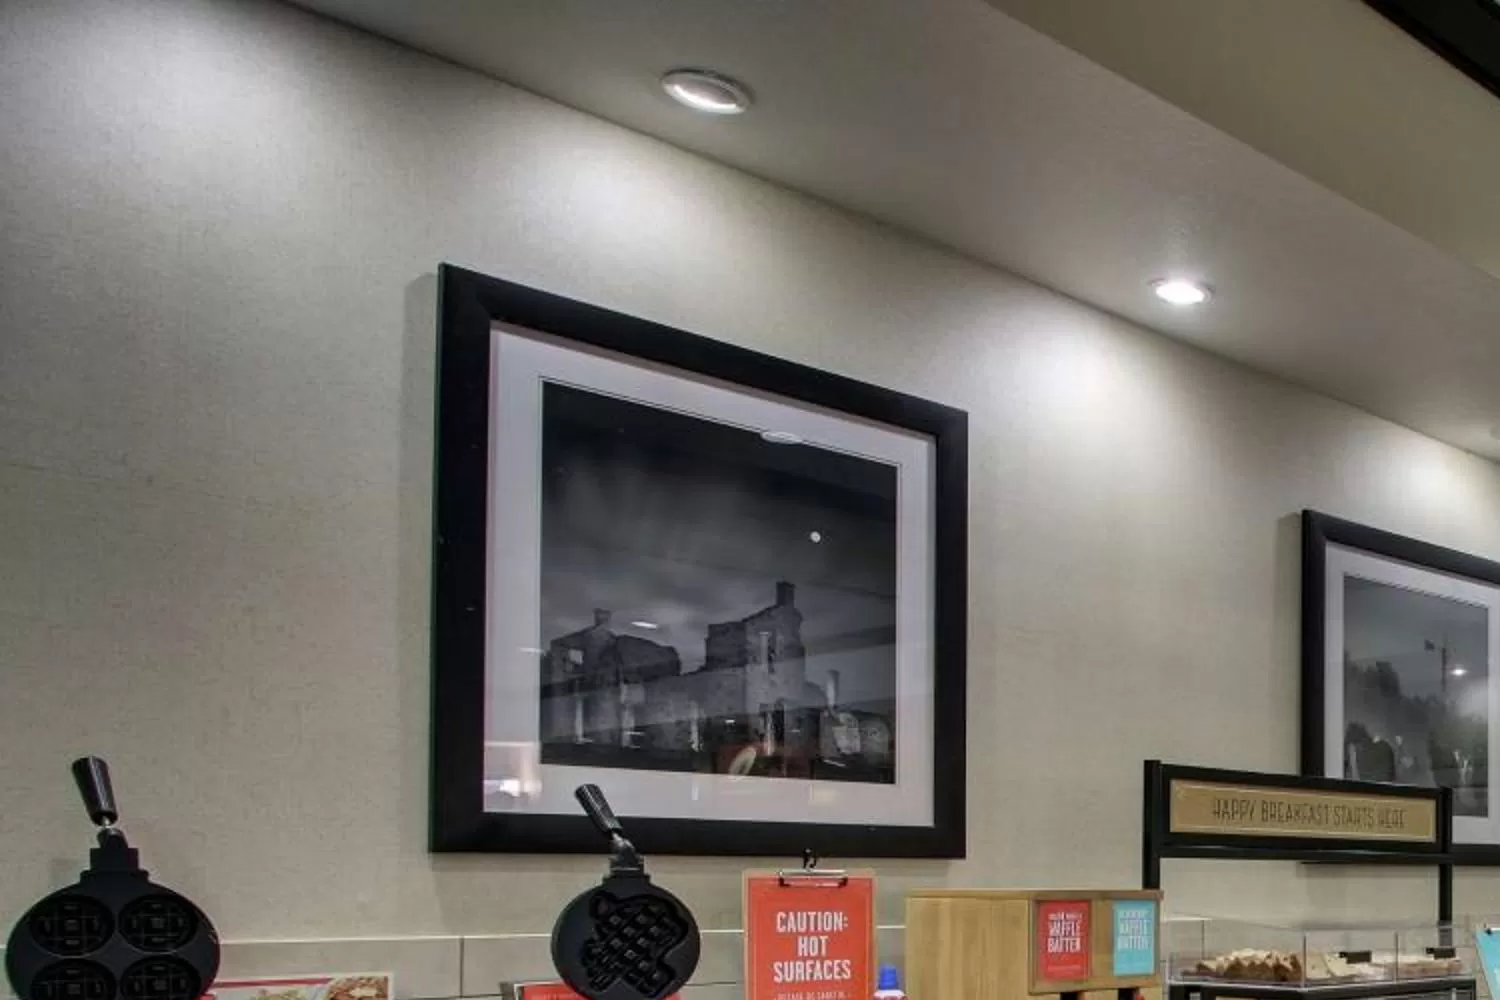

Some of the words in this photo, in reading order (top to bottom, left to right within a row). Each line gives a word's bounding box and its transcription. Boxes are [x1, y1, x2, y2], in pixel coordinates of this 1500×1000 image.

[1212, 798, 1256, 821] HAPPY
[1261, 800, 1329, 825] BREAKFAST
[1333, 804, 1374, 829] STARTS
[776, 911, 848, 933] CAUTION:
[798, 935, 829, 957] HOT
[773, 959, 852, 984] SURFACES
